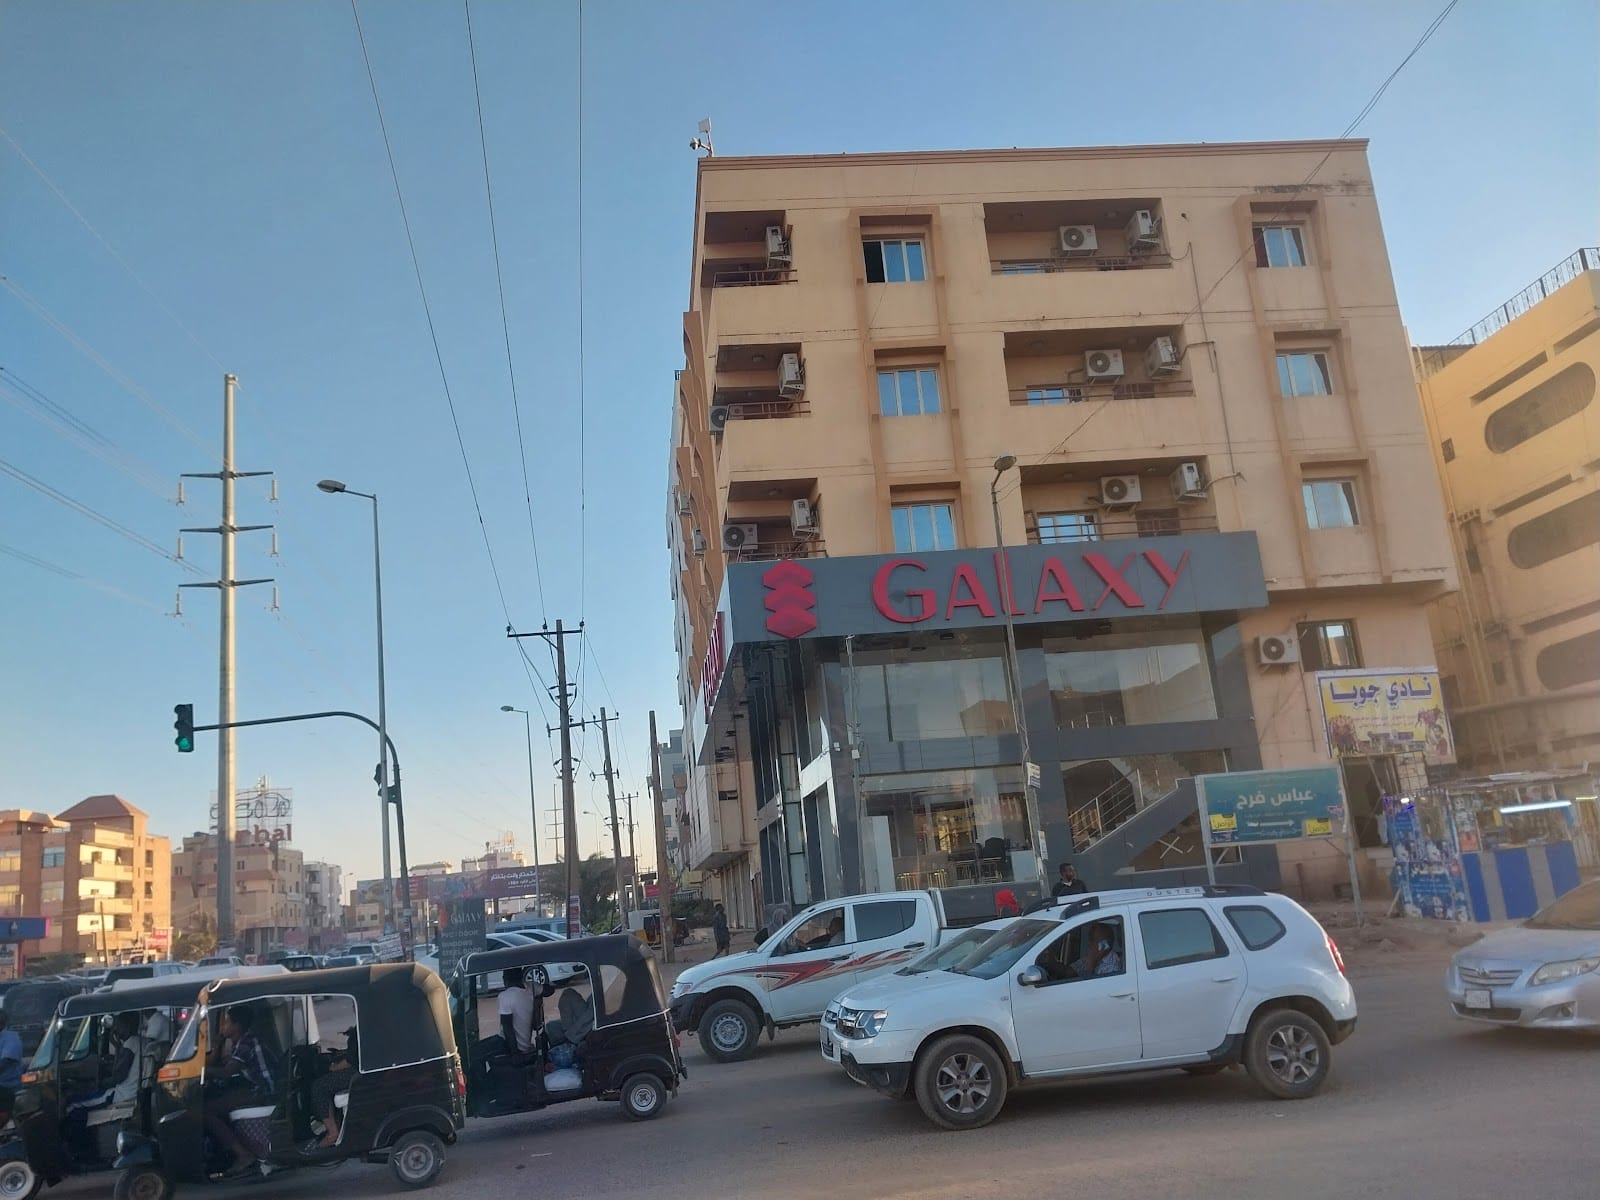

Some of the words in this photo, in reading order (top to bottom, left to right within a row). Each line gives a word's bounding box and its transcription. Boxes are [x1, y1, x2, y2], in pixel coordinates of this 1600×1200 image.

[871, 548, 1192, 624] GALAXY
[1330, 681, 1380, 707] جوبا
[1385, 676, 1432, 706] نادي
[1271, 787, 1315, 806] عباس
[1146, 887, 1201, 897] DUSTER
